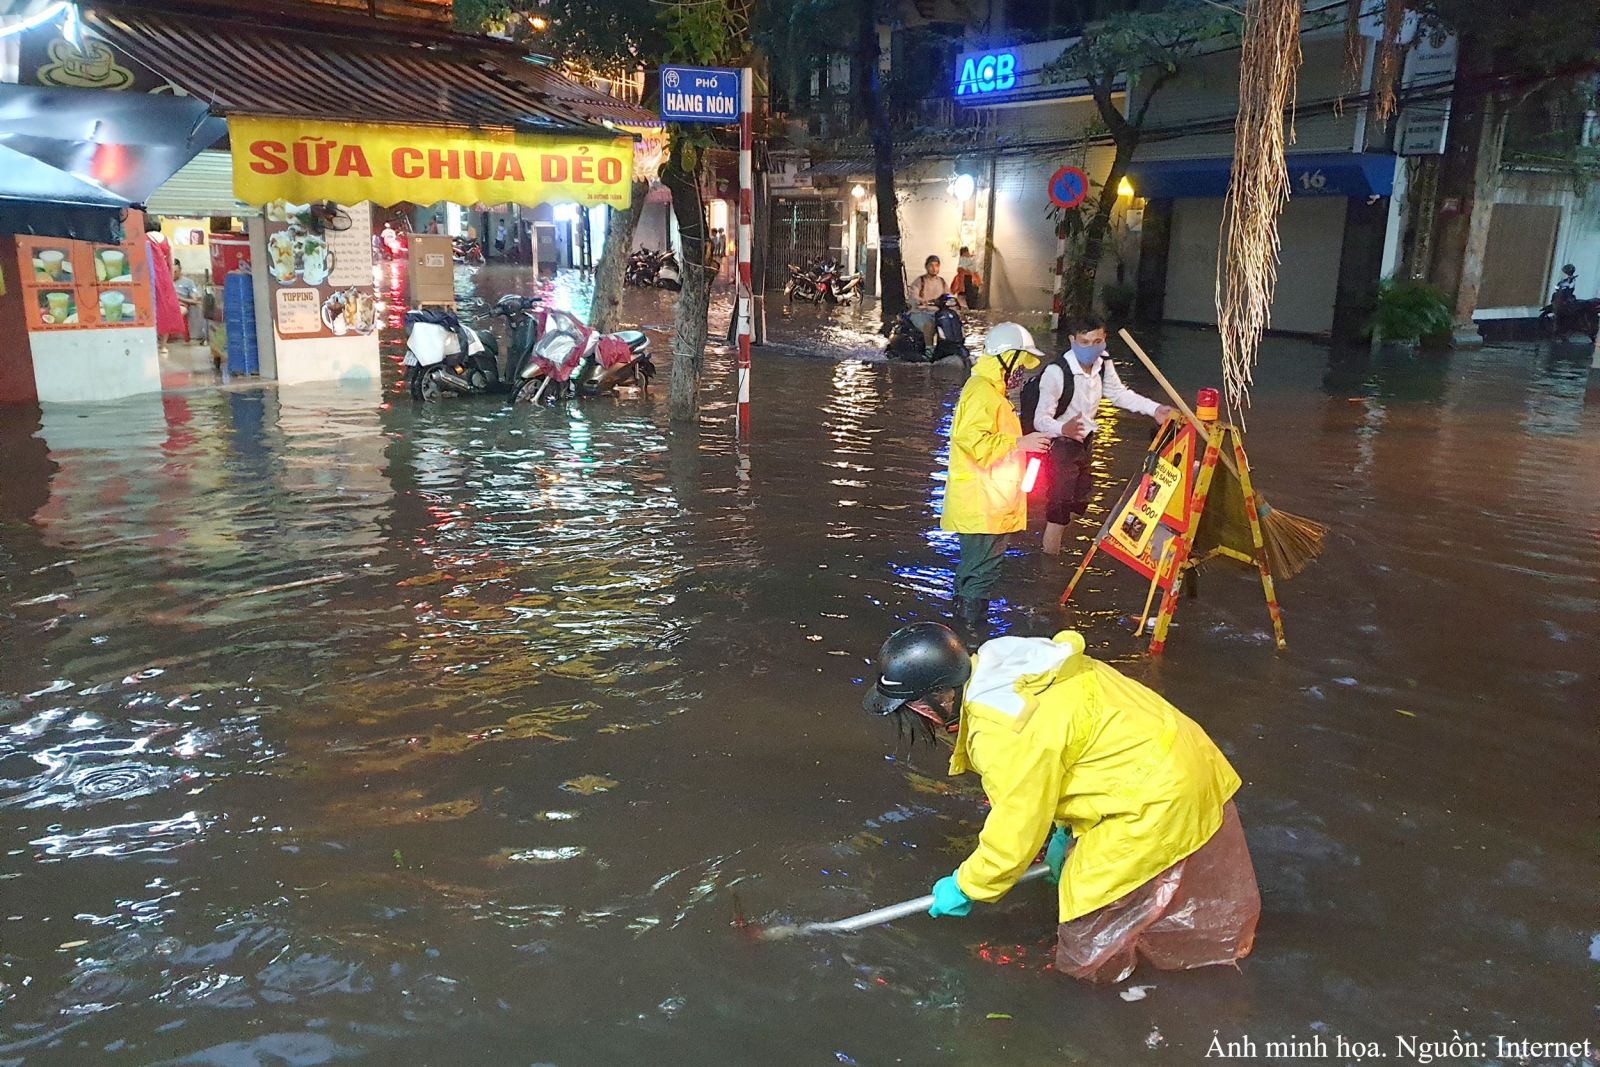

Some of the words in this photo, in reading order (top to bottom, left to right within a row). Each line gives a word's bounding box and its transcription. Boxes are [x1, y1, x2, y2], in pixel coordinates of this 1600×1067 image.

[695, 75, 718, 88] PHỐ
[957, 53, 1016, 95] ACB
[666, 89, 703, 113] HÀNG
[706, 92, 734, 114] NÓN
[249, 135, 373, 178] SỮA
[391, 147, 526, 182] CHUA
[540, 146, 622, 185] DẺO
[1299, 168, 1327, 190] 16
[281, 291, 314, 302] TOPPING
